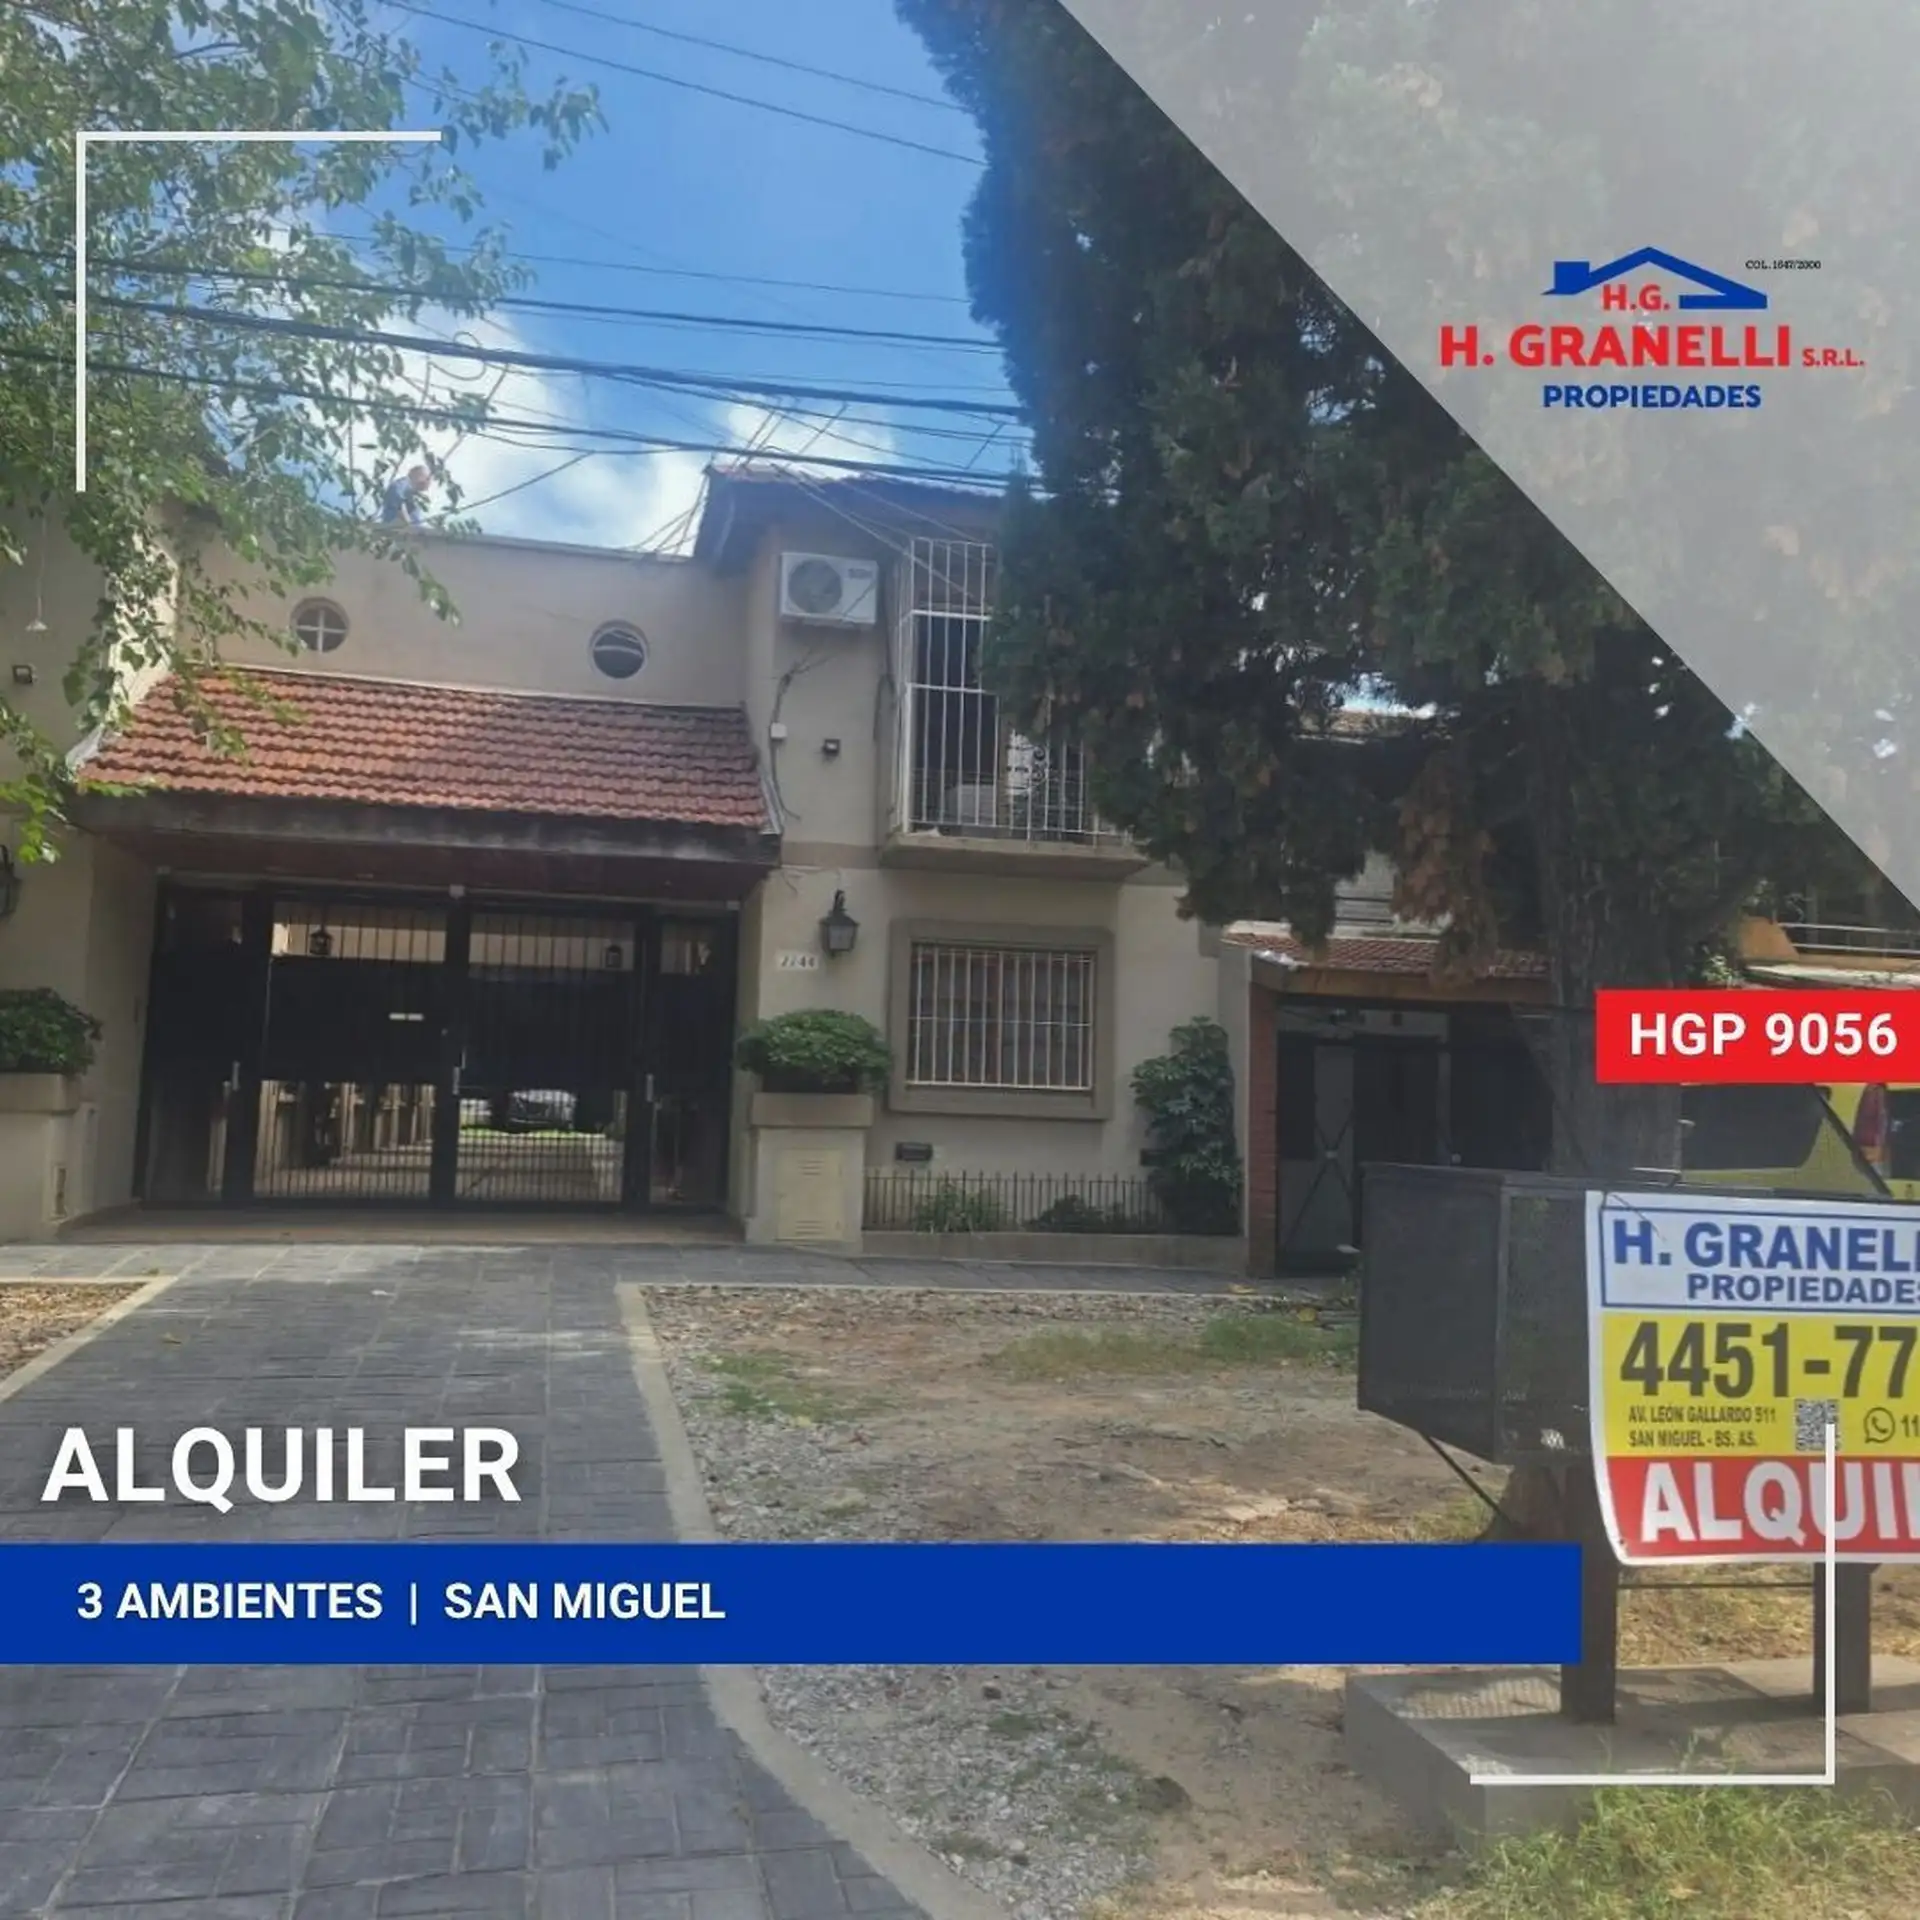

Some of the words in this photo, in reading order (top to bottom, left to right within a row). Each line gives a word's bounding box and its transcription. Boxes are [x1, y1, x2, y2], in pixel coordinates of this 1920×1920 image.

[1612, 1219, 1672, 1265] H.
[1684, 1222, 1920, 1272] GRANEL
[1687, 1274, 1920, 1304] PROPIEDADE
[1687, 1405, 1751, 1423] GALLARDO
[1628, 1429, 1655, 1448] SAN
[1657, 1430, 1705, 1448] MIGUEL
